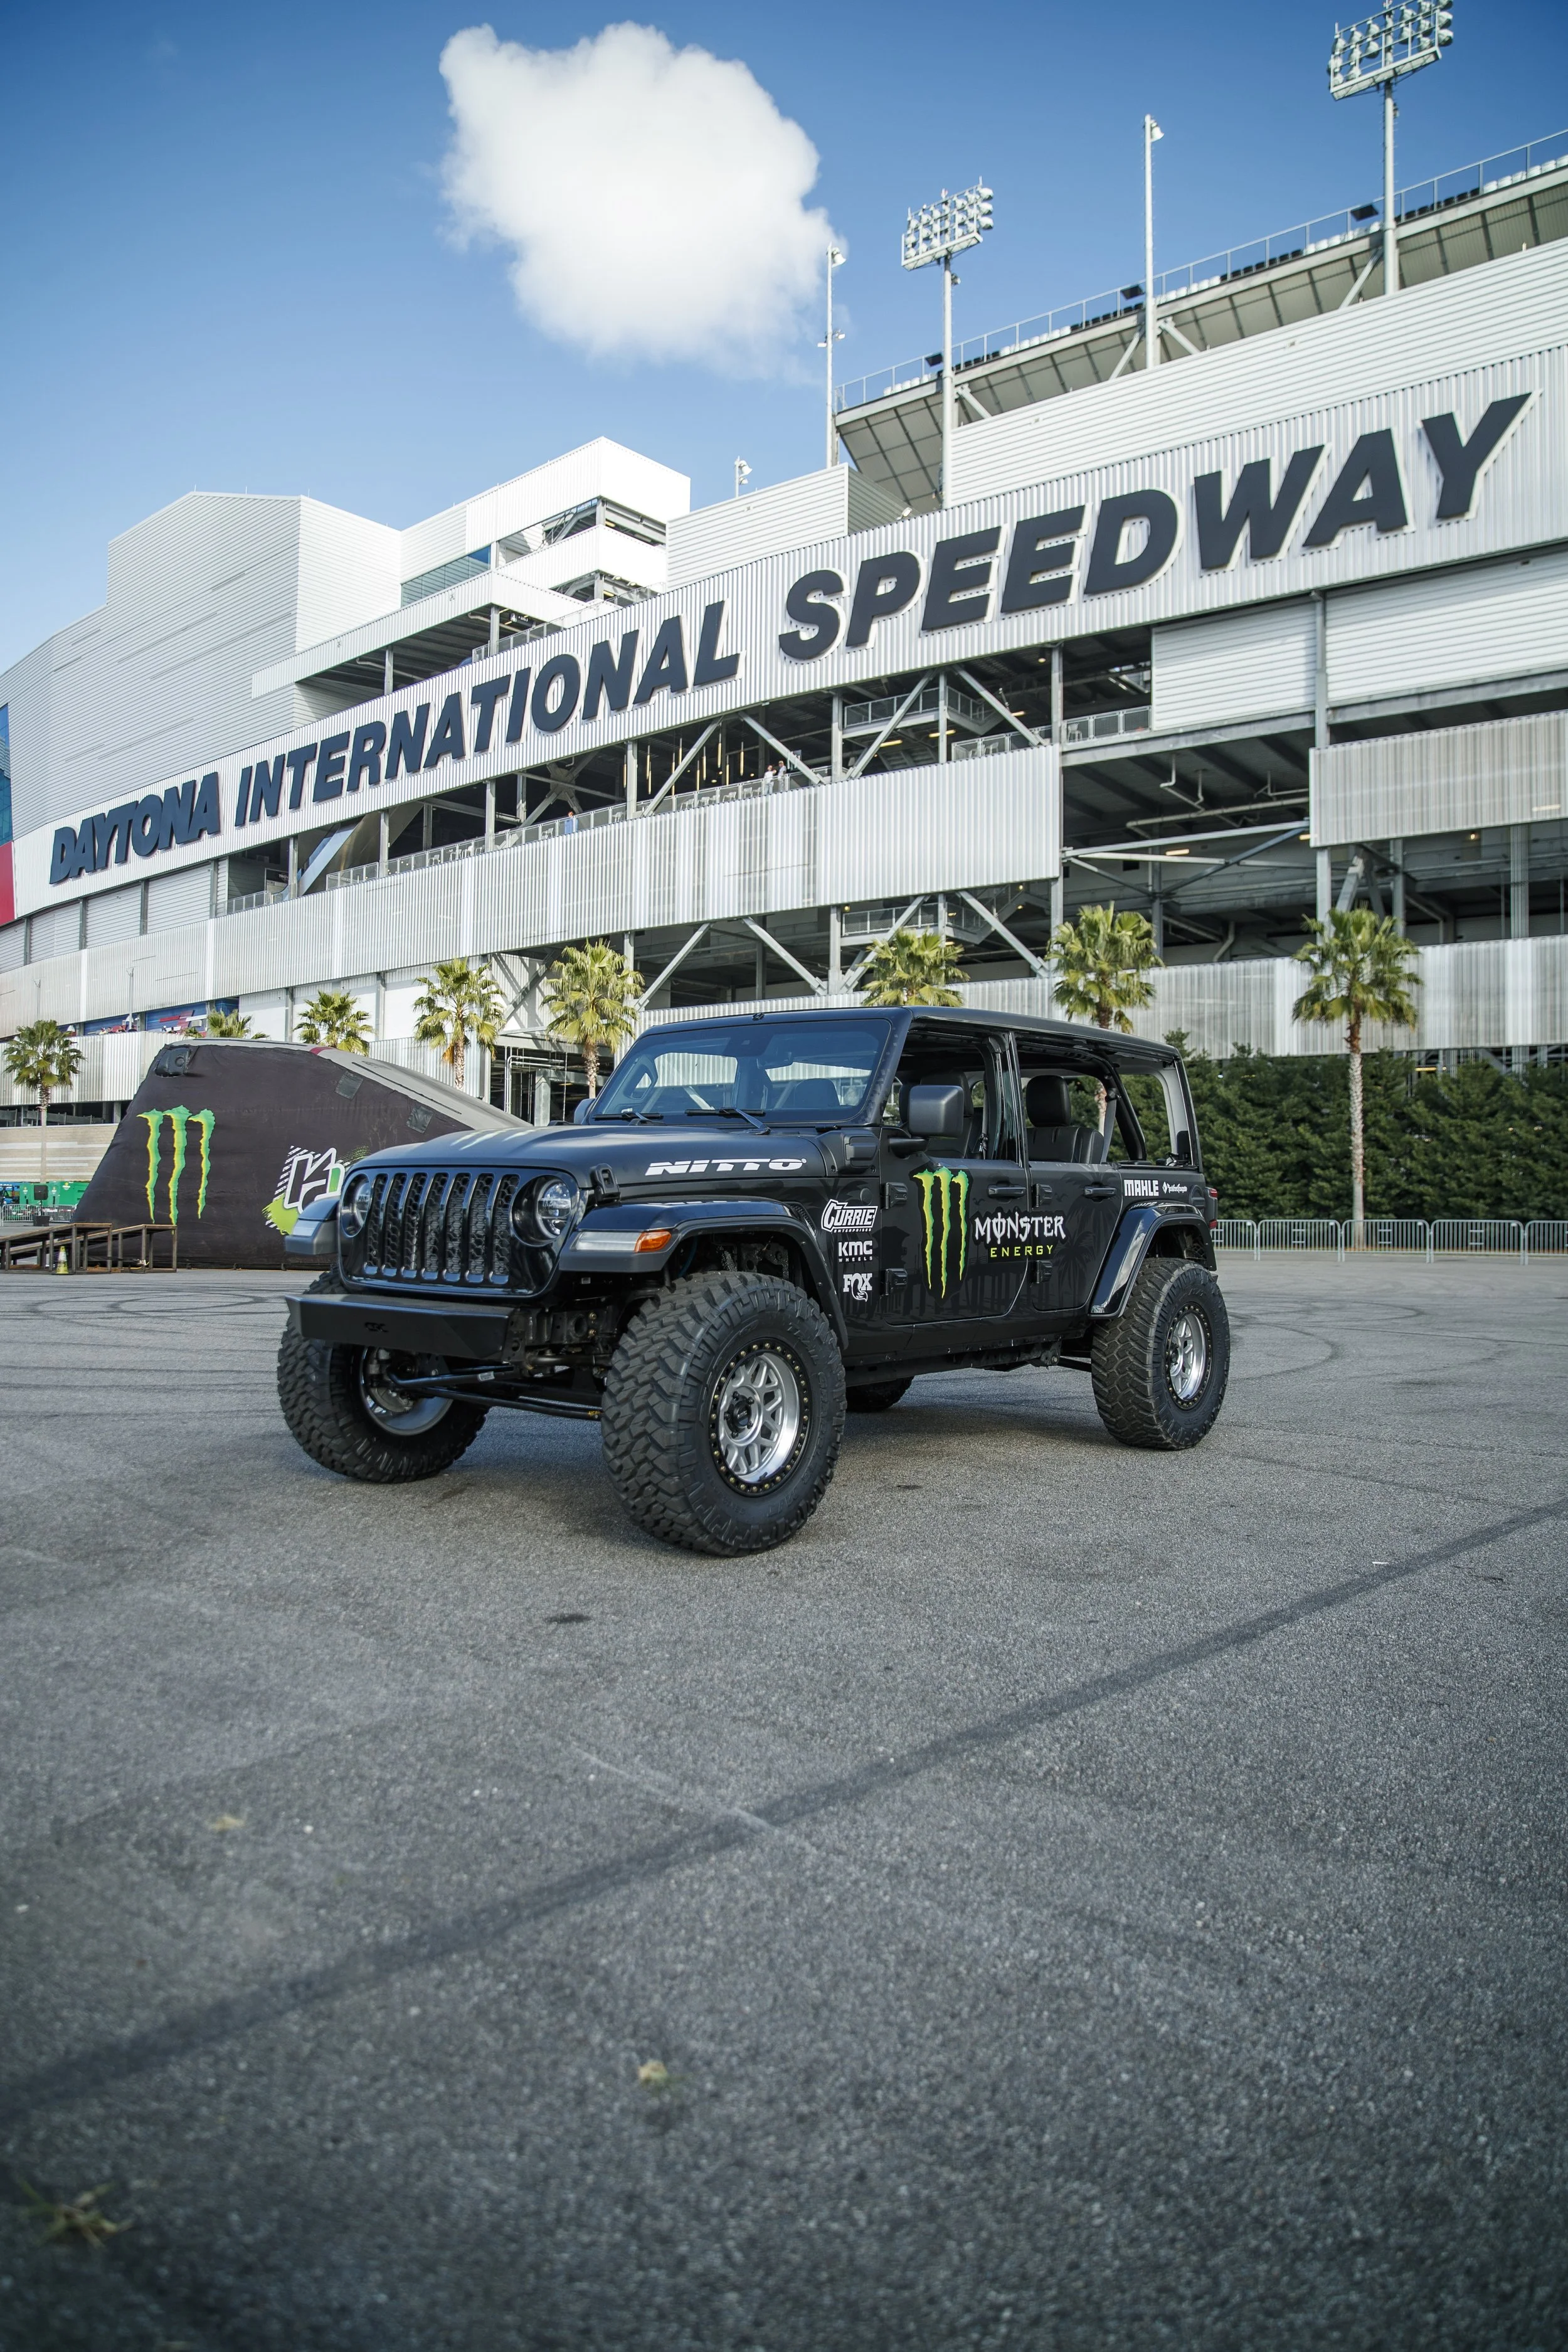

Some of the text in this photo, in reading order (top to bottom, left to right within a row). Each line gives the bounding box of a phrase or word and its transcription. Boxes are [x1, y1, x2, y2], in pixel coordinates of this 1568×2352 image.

[50, 392, 1533, 884] DAYTONA INTERNATIONAL SPEEDWAY
[645, 1158, 803, 1177] NITTO
[1124, 1179, 1159, 1196] MAHLE
[824, 1202, 875, 1229] CURRIE
[838, 1240, 873, 1257] KMC
[990, 1245, 1053, 1258] ENERGY
[843, 1273, 872, 1302] FOX
